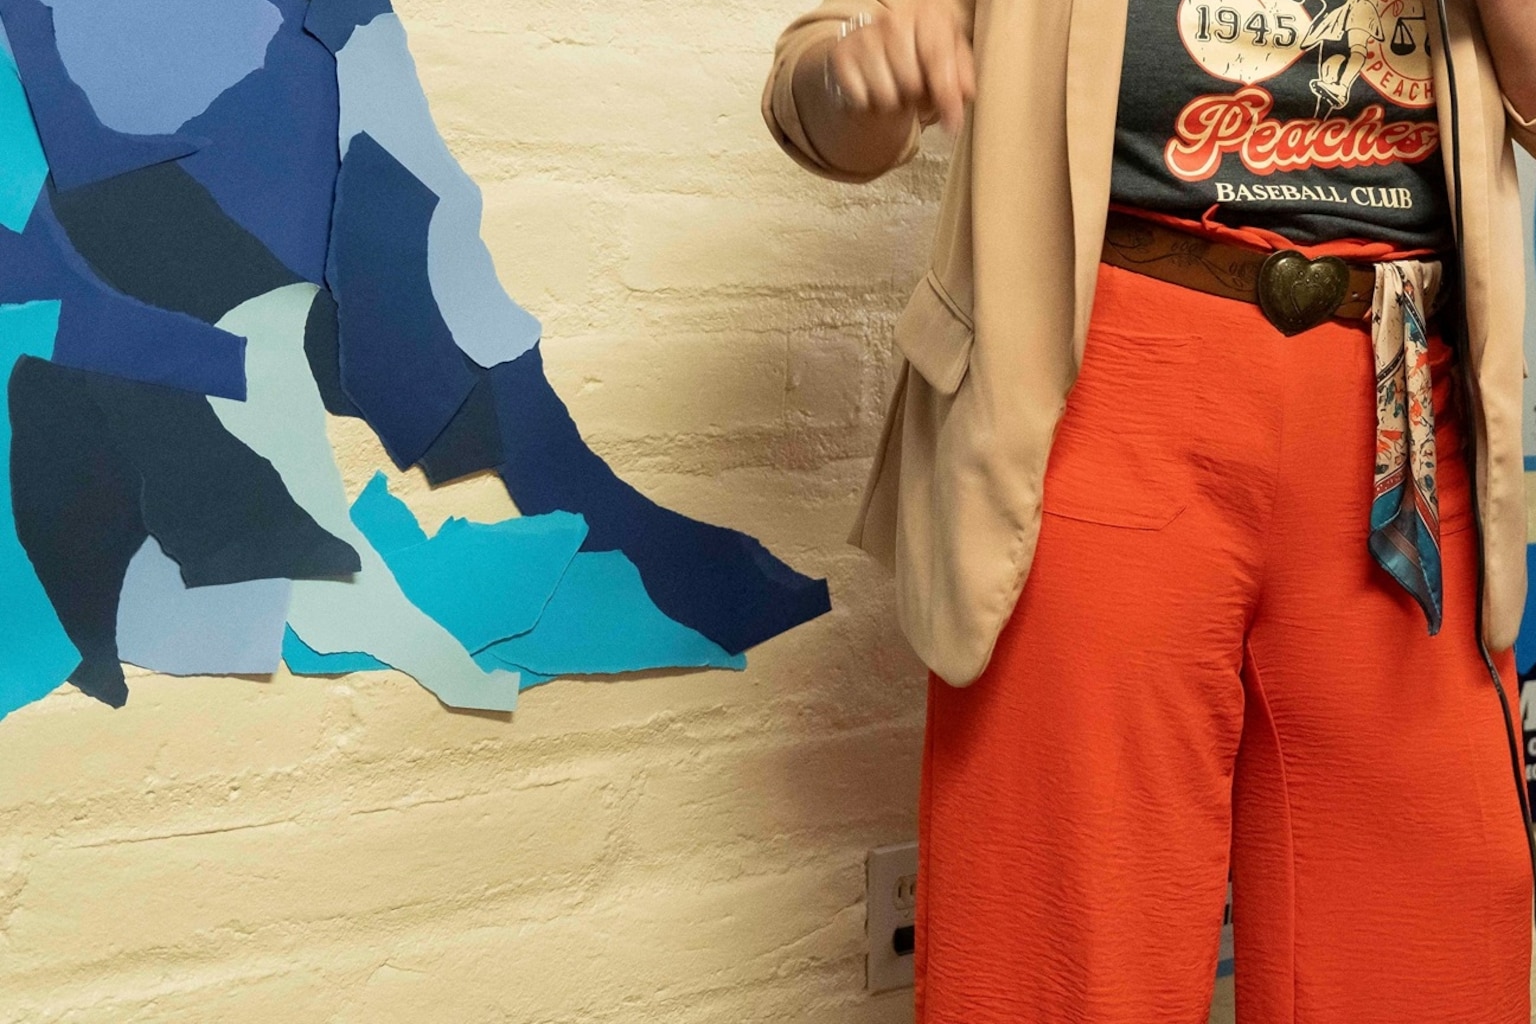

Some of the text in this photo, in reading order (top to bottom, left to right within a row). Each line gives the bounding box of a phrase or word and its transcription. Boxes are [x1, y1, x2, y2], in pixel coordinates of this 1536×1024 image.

[1195, 4, 1298, 48] 1945
[1366, 59, 1434, 102] PEACH
[1164, 83, 1441, 182] Peaches
[1214, 182, 1413, 210] BASEBALL CLUB
